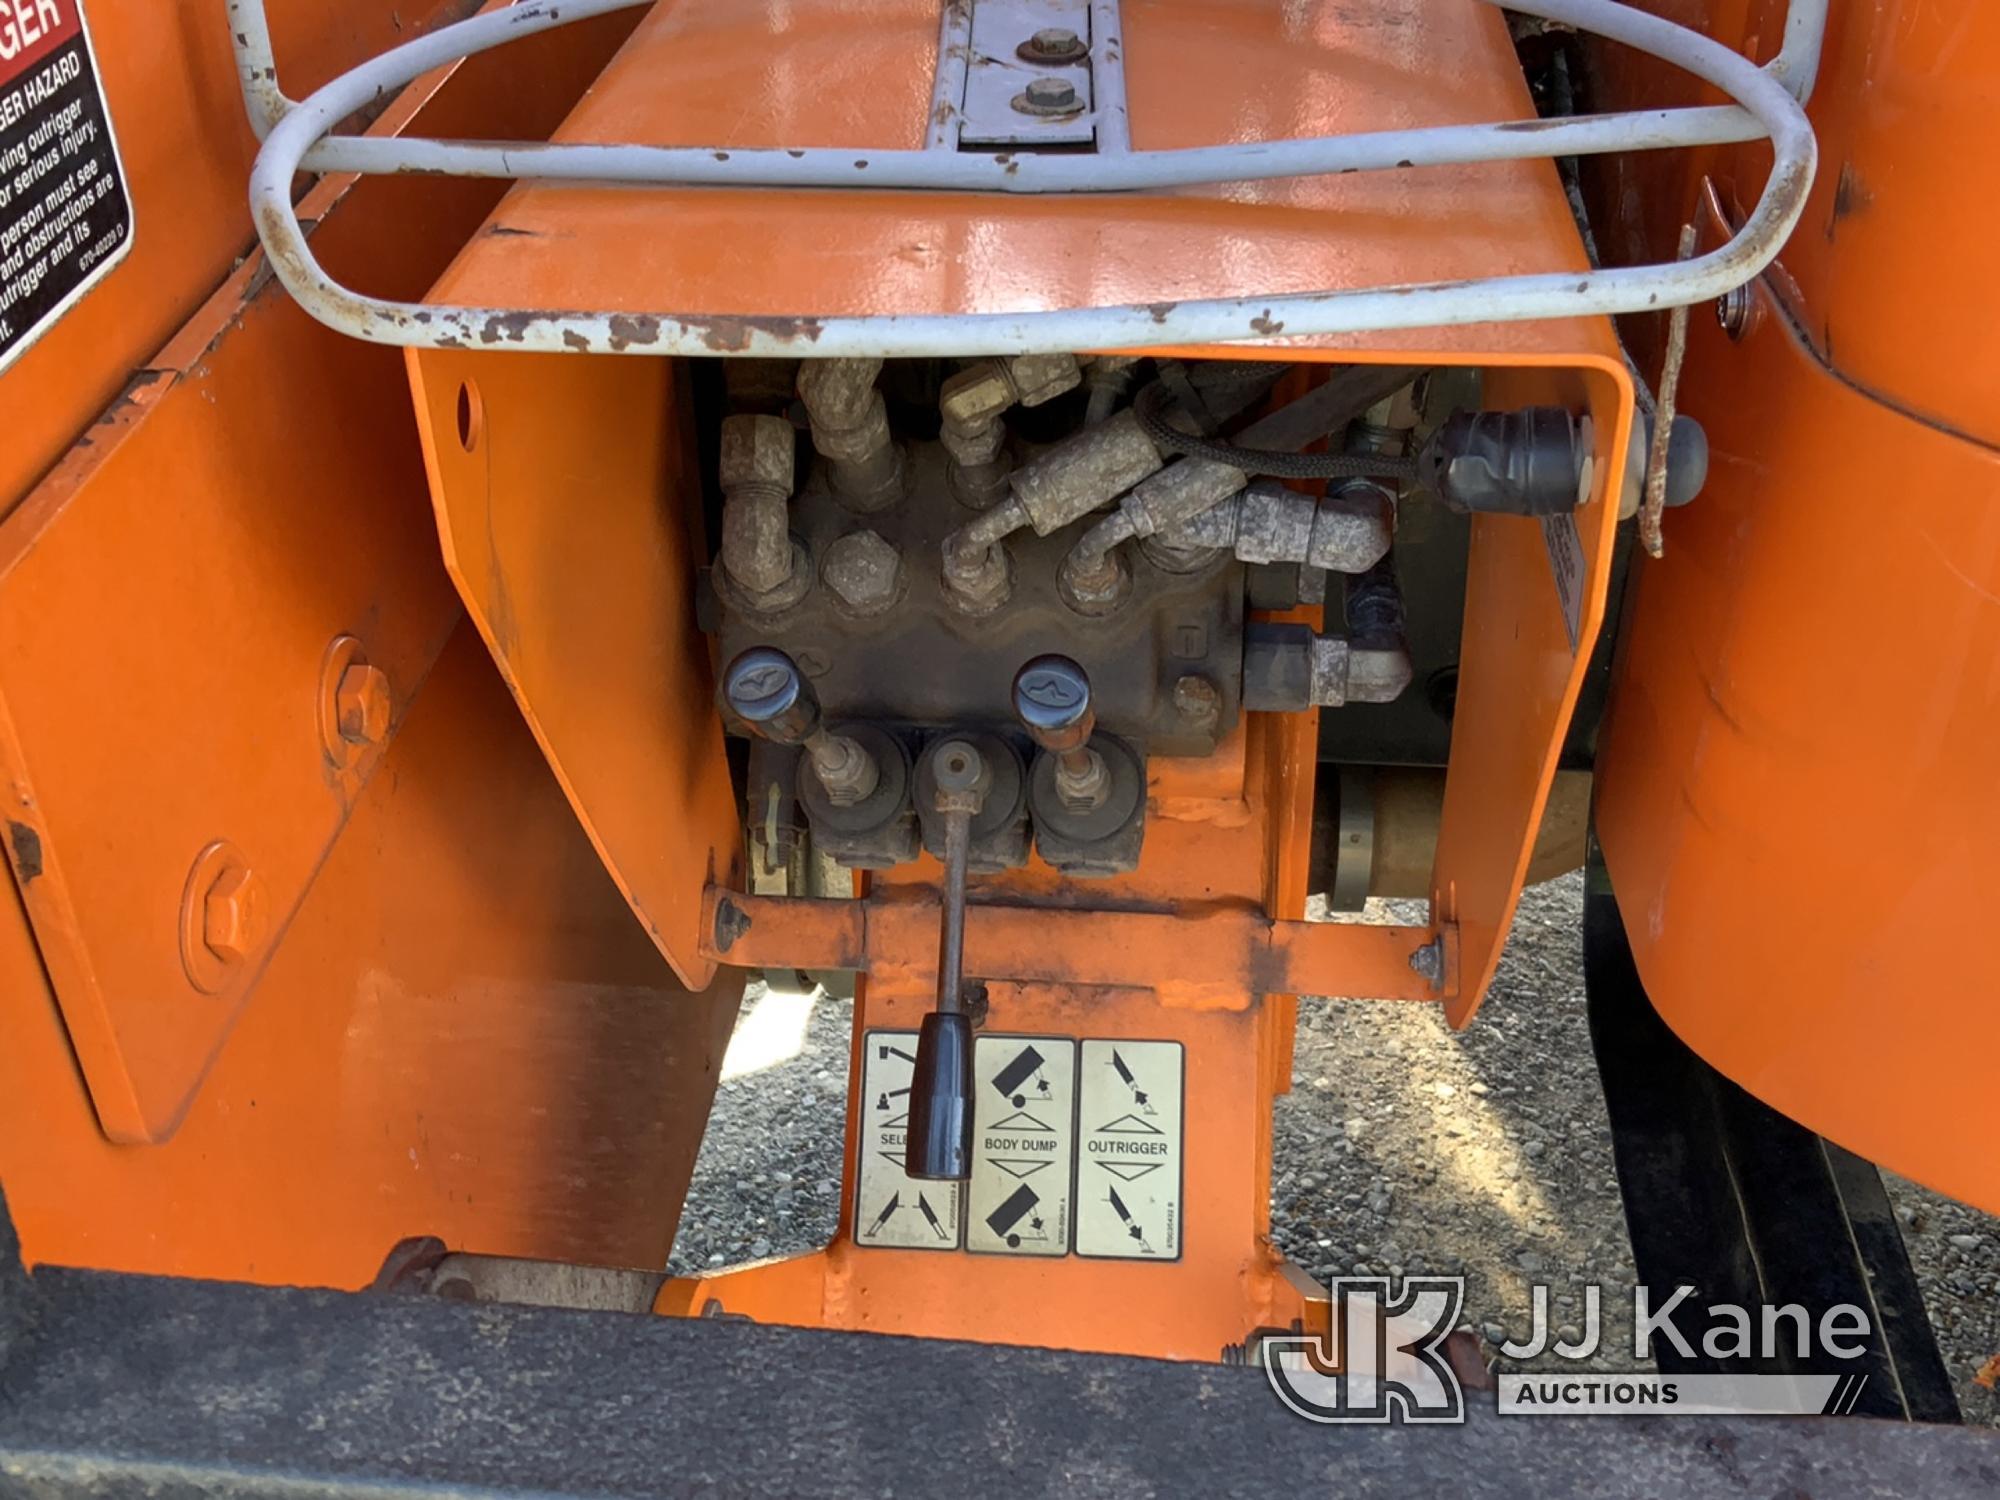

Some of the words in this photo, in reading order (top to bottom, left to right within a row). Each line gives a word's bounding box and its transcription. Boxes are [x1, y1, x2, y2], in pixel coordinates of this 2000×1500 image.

[23, 50, 80, 110] HAZARD
[14, 147, 60, 195] serious
[59, 119, 98, 157] injury.
[28, 98, 81, 152] outrigger
[0, 203, 45, 256] person
[45, 173, 76, 213] must
[76, 159, 98, 187] see
[0, 245, 24, 281] and
[24, 189, 95, 259] obstructions
[95, 172, 114, 199] are
[0, 255, 48, 316] utrigger
[50, 231, 74, 267] and
[72, 221, 91, 245] its
[985, 1138, 1018, 1150] BODY
[1022, 1140, 1057, 1151] DUMP
[1088, 1141, 1167, 1155] OUTRIGGER
